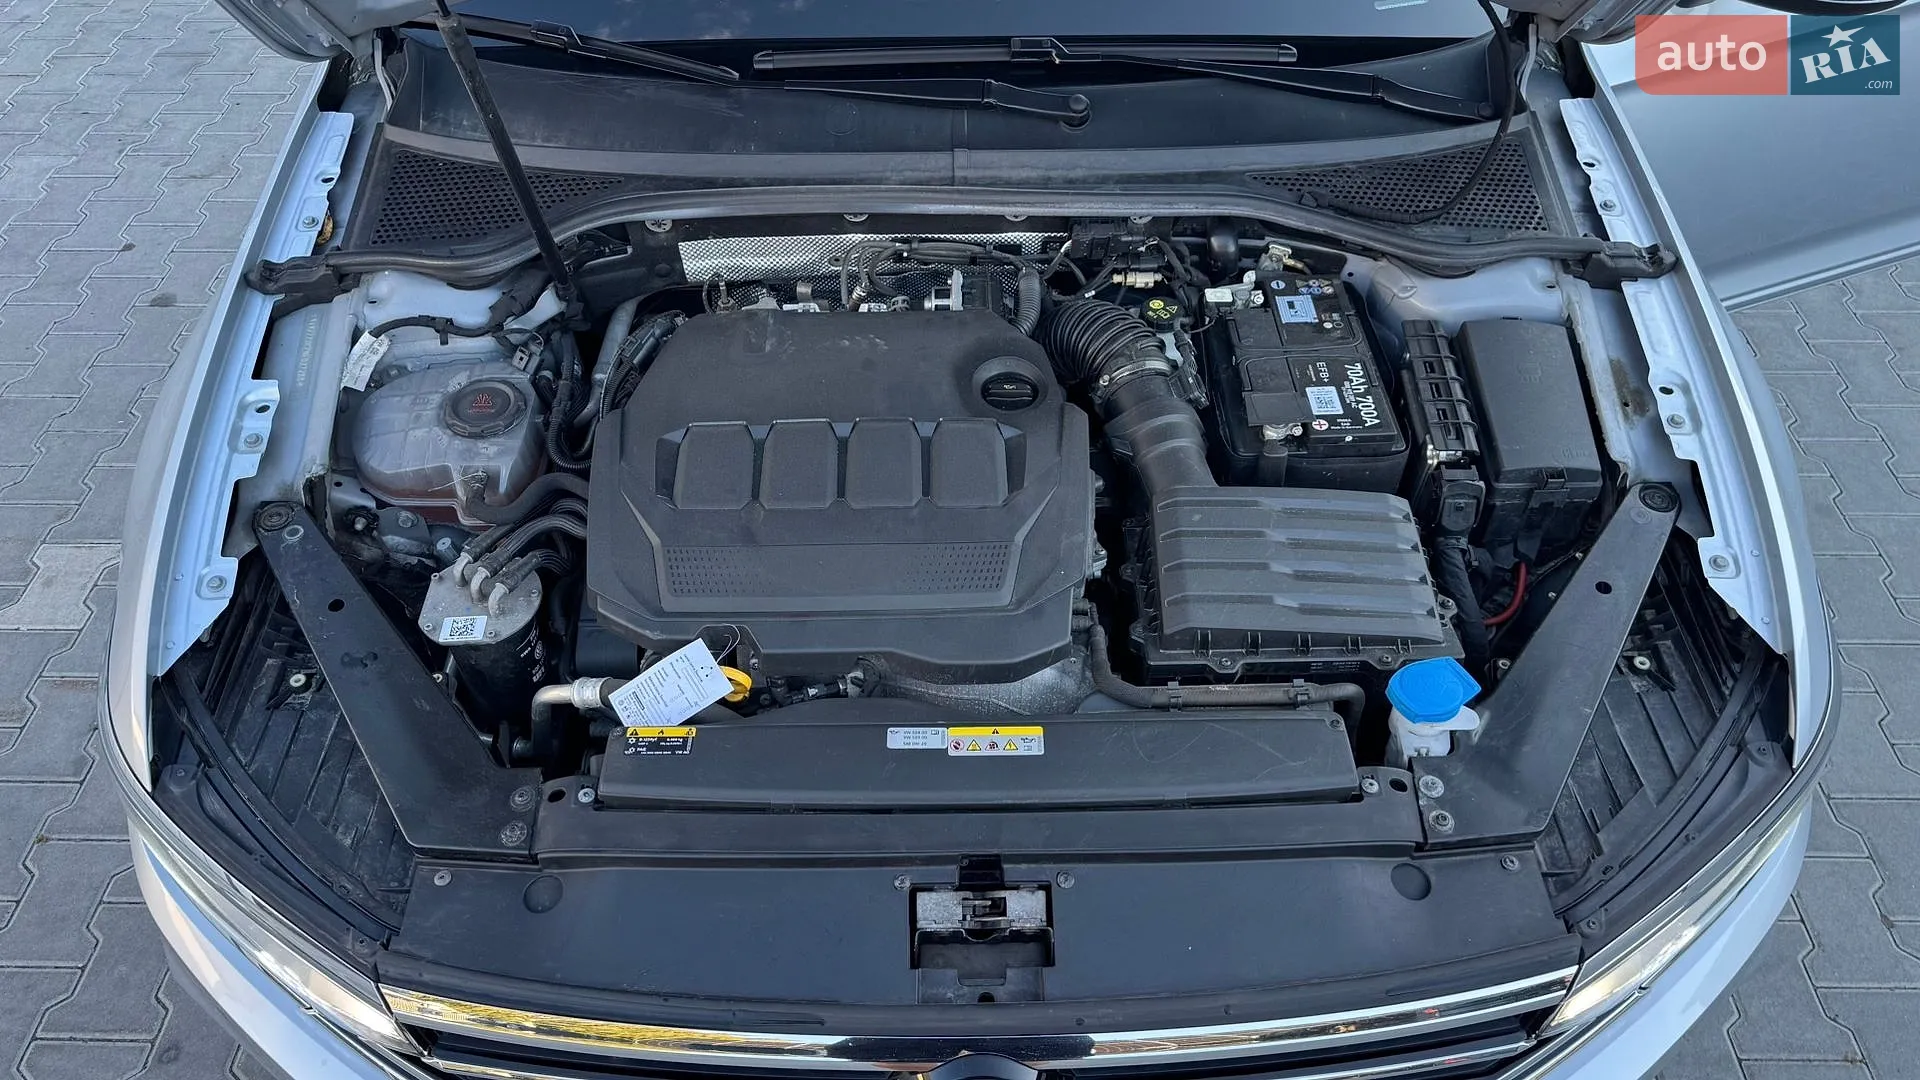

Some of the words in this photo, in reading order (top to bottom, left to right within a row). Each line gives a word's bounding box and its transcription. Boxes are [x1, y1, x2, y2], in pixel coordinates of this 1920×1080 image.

[1316, 361, 1330, 383] EFB+
[1344, 362, 1368, 393] 70Ah
[1356, 395, 1381, 427] 700A
